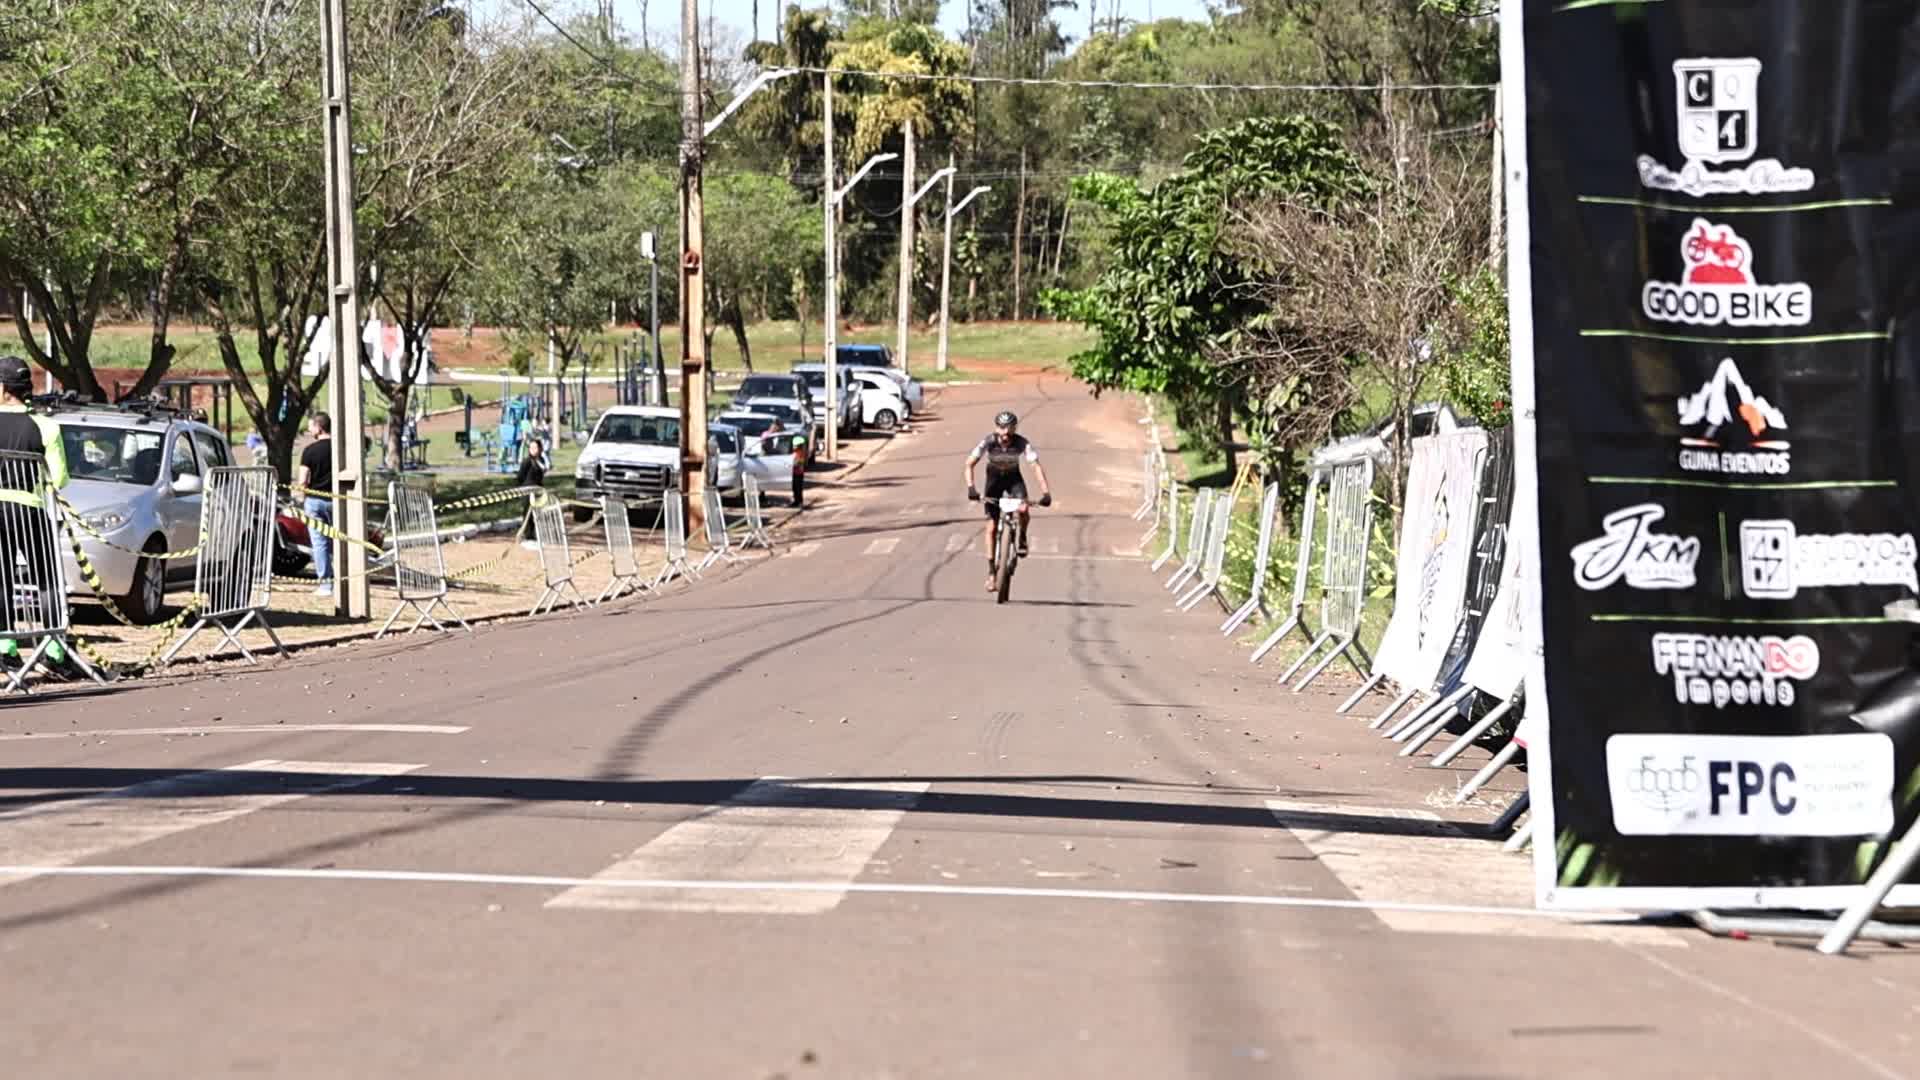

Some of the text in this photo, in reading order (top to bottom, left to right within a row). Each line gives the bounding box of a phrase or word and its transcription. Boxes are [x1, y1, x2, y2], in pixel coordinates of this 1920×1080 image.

[1689, 72, 1709, 102] C
[1649, 285, 1805, 319] GOOD BIKE
[1721, 451, 1791, 474] EVENTOS
[1655, 635, 1815, 676] FERNANDO
[1709, 761, 1797, 816] FPC
